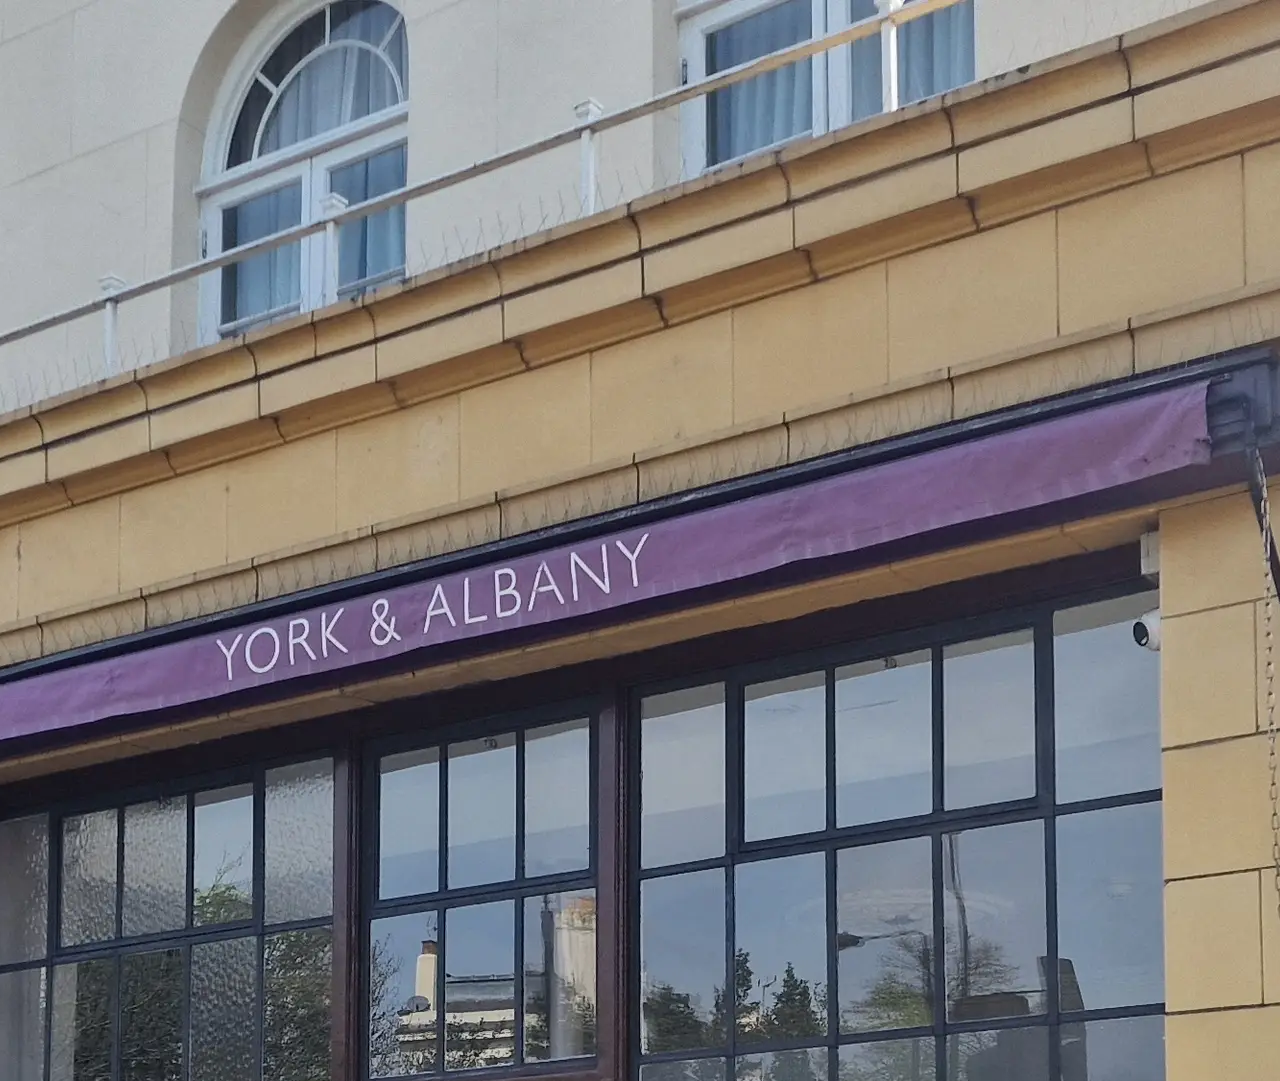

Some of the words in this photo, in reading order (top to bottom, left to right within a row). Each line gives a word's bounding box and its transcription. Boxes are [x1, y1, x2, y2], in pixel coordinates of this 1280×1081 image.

[217, 608, 348, 681] YORK
[370, 598, 401, 646] &
[423, 534, 650, 633] ALBANY
